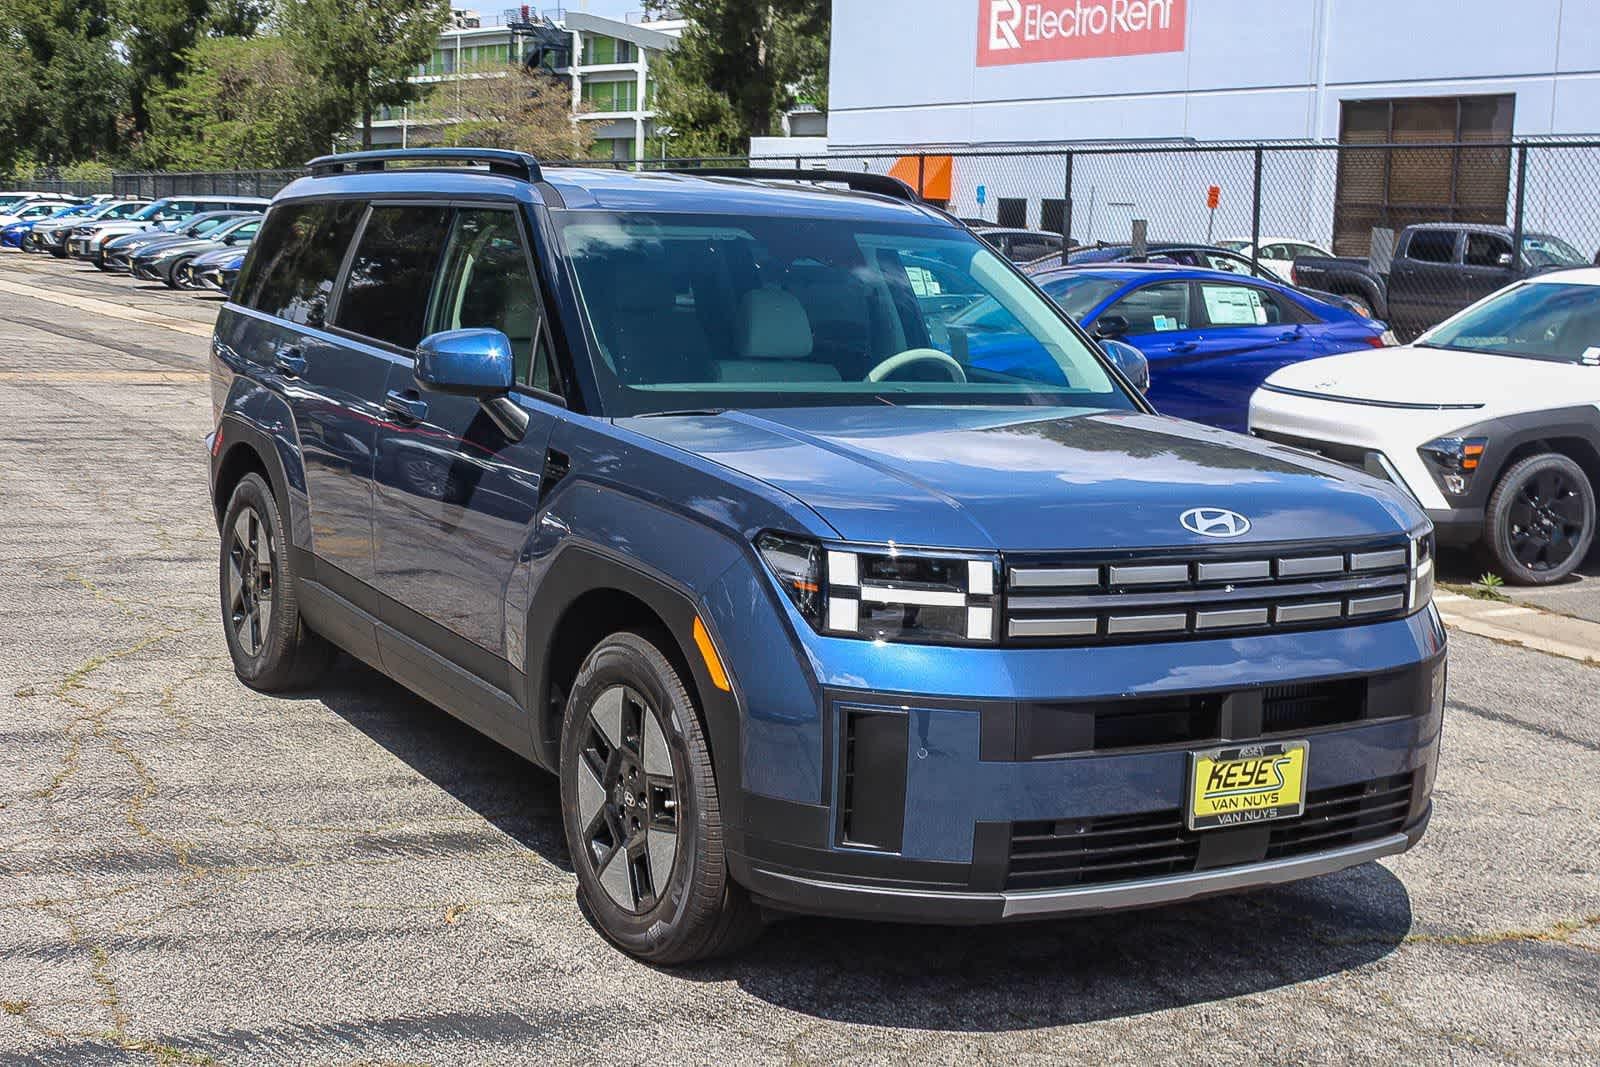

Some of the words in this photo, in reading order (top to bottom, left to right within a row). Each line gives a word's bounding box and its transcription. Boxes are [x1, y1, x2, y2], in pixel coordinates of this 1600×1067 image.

[1204, 757, 1292, 791] KEYES
[1212, 798, 1239, 811] VAN
[1243, 793, 1279, 807] NUYS
[1218, 813, 1240, 824] VAN
[1244, 808, 1277, 820] NUYS
